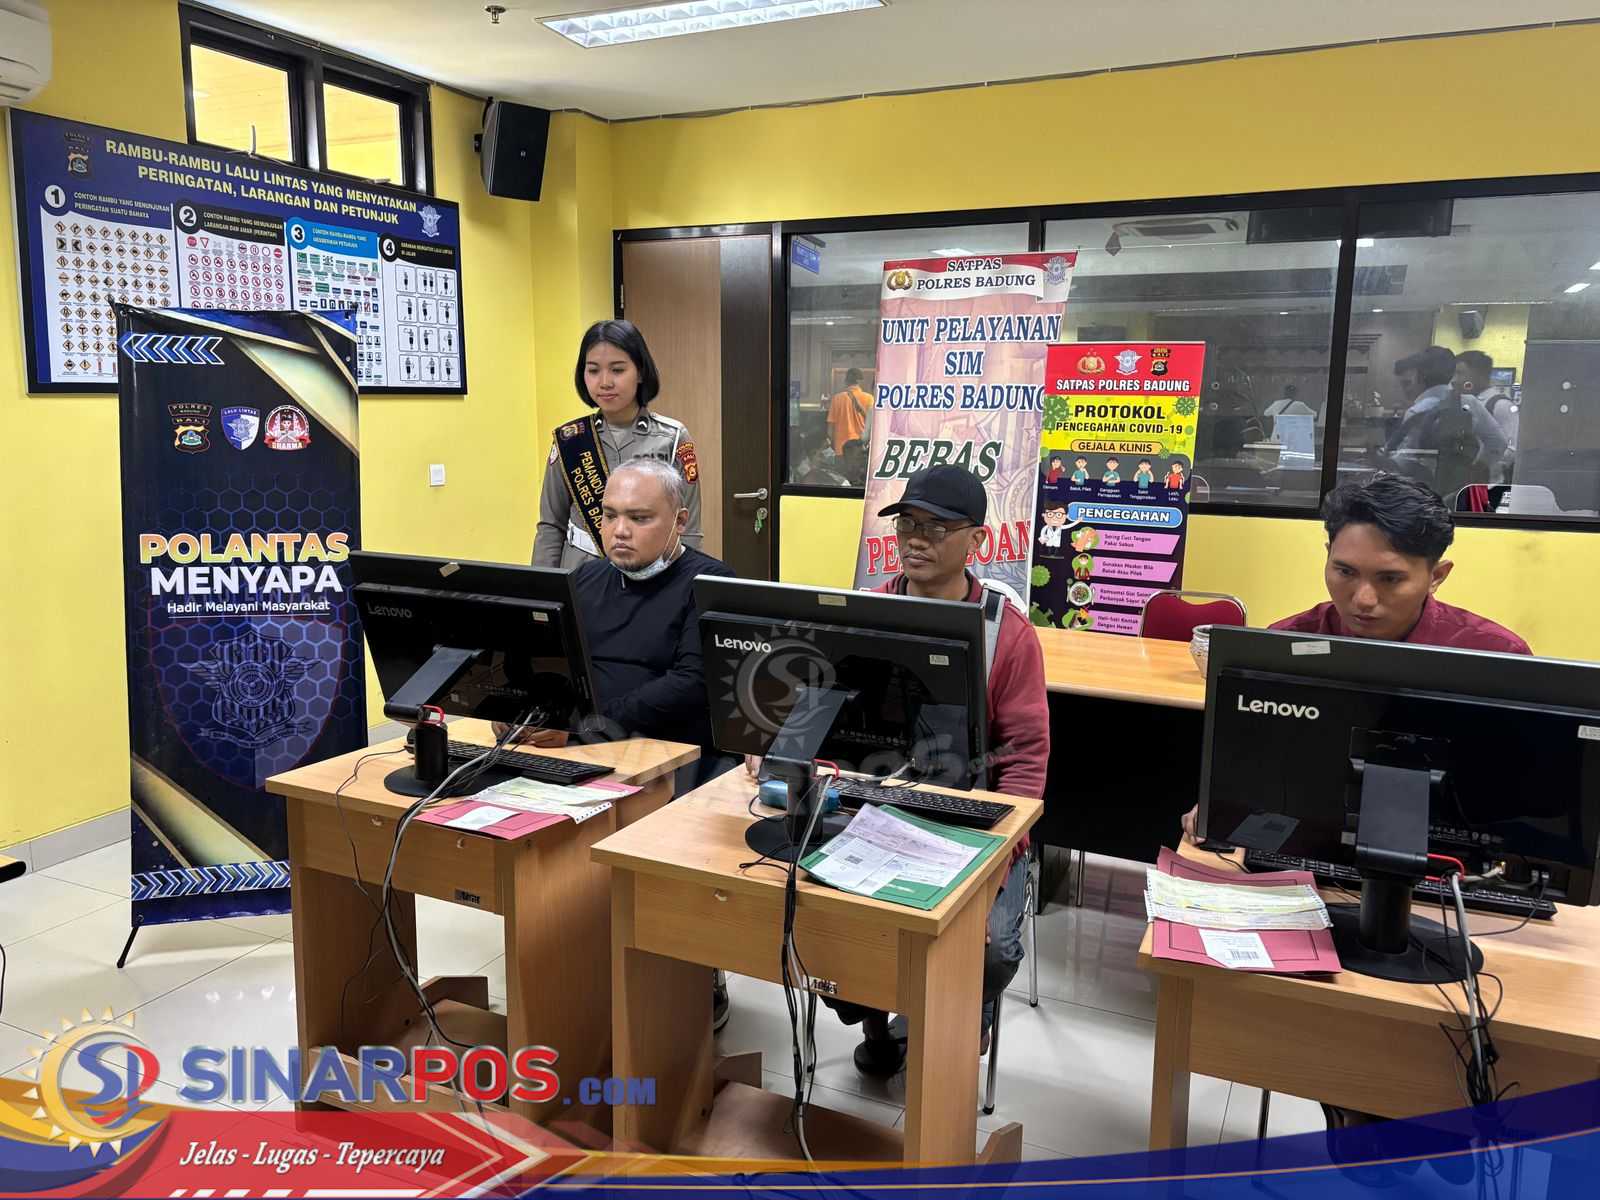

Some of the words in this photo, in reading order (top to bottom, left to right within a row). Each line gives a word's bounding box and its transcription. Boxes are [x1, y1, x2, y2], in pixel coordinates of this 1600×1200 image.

[105, 139, 221, 173] RAMBU-RAMBU
[225, 163, 260, 182] LALU
[263, 171, 308, 191] LINTAS
[311, 181, 343, 199] YANG
[346, 189, 417, 213] MENYATAKAN
[51, 188, 60, 205] 1
[138, 165, 238, 198] PERINGATAN,
[241, 185, 311, 209] LARANGAN
[314, 199, 338, 214] DAN
[341, 204, 400, 225] PETUNJUK
[183, 208, 194, 223] 2
[294, 226, 303, 241] 3
[385, 241, 394, 254] 4
[947, 257, 1002, 273] SATPAS
[916, 277, 971, 290] POLRES
[975, 274, 1036, 288] BADUNG
[881, 318, 929, 344] UNIT
[934, 314, 1062, 342] PELAYANAN
[944, 351, 984, 376] SIM
[1056, 379, 1095, 391] SATPAS
[1098, 379, 1141, 391] POLRES
[1143, 380, 1190, 392] BADUNG
[876, 384, 955, 410] POLRES
[1074, 404, 1166, 420] PROTOKOL
[1056, 421, 1126, 433] PENCEGAHAN
[1129, 423, 1183, 434] COVID-19
[1078, 441, 1119, 452] GEJALA
[1119, 442, 1153, 454] KLINIS
[579, 450, 605, 495] PEMANDU
[570, 466, 594, 506] POLRES
[1077, 507, 1170, 522] PENCEGAHAN
[139, 531, 350, 565] POLANTAS
[151, 565, 343, 596] MENYAPA
[167, 602, 201, 613] Hadir
[206, 601, 258, 614] Melayani
[262, 599, 330, 613] Masyarakat
[367, 602, 413, 619] Lenovo
[714, 633, 772, 653] Lenovo
[1237, 694, 1320, 720] Lenovo
